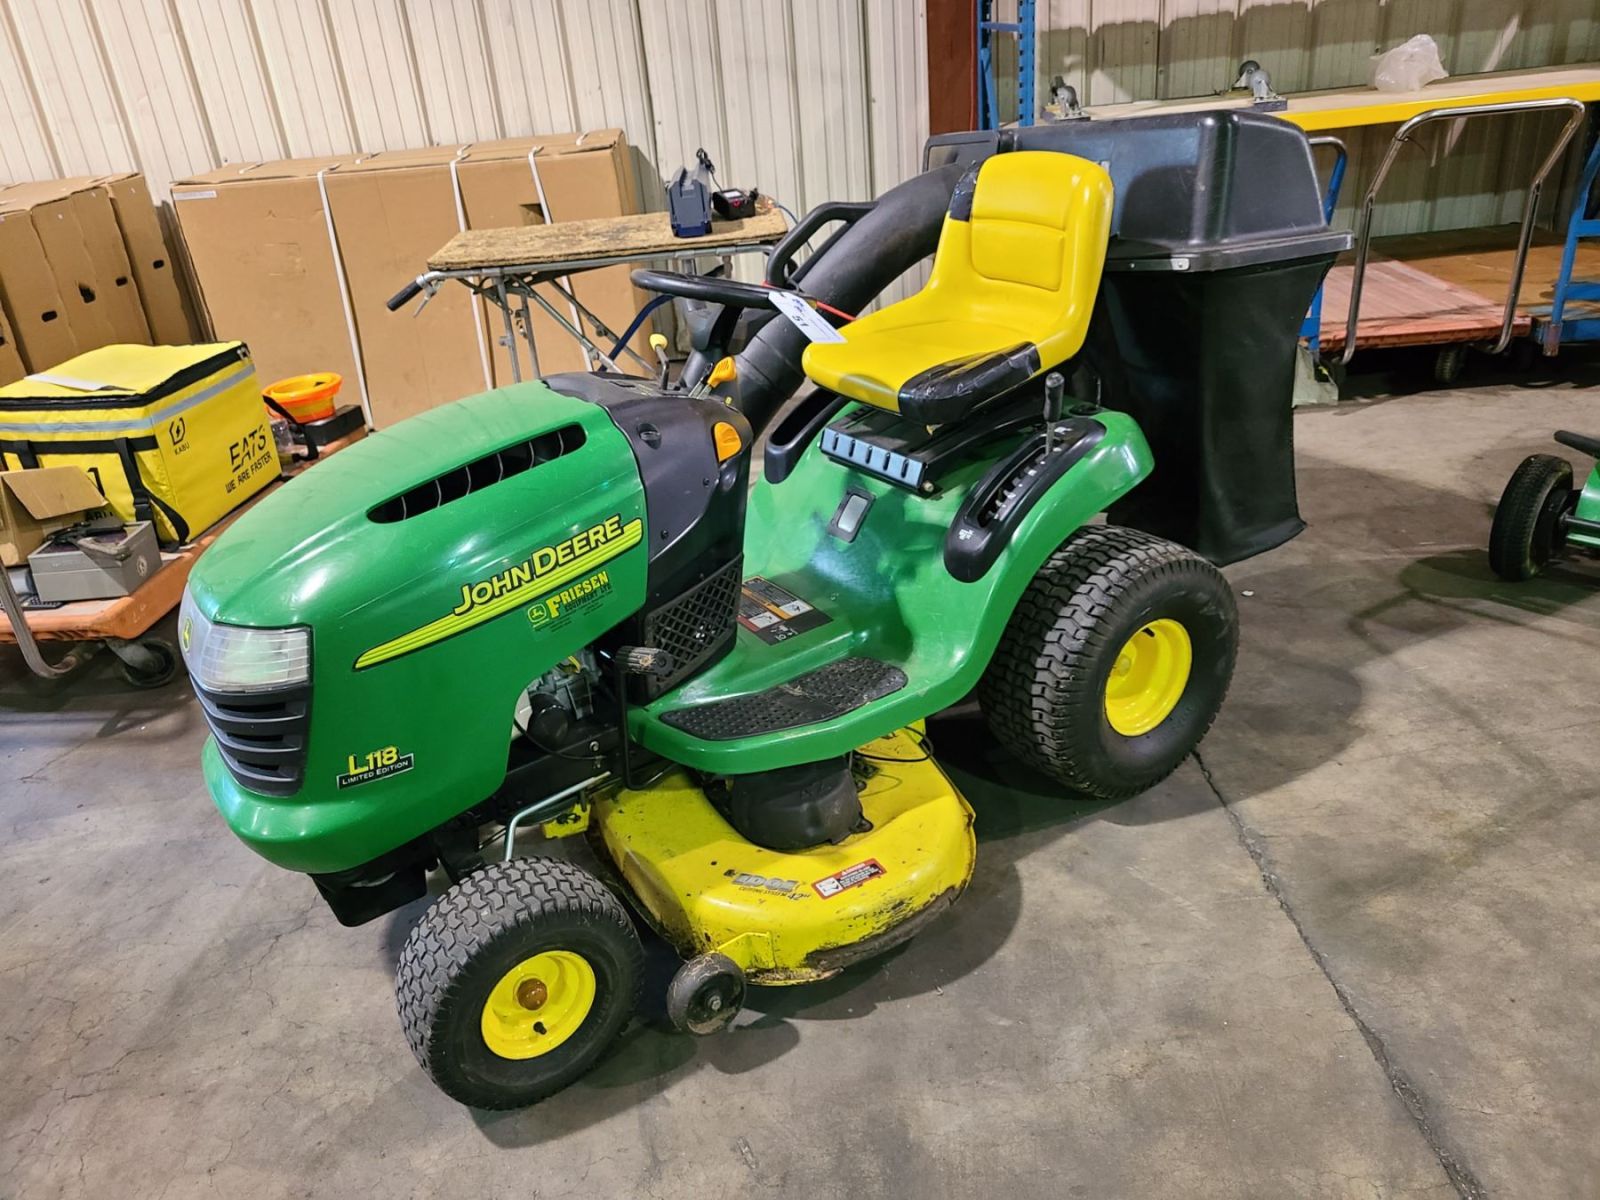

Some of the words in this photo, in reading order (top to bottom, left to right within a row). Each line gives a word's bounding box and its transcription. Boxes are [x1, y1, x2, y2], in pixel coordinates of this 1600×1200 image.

[229, 424, 267, 473] EATS
[225, 479, 236, 494] WE
[237, 468, 251, 485] ARE
[250, 451, 273, 475] FASTER
[454, 561, 532, 615] JOHN
[532, 515, 623, 577] DEERE
[546, 571, 609, 618] FRIESEN
[342, 770, 375, 785] LIMITED
[376, 760, 409, 775] EDITION
[348, 745, 398, 776] L118
